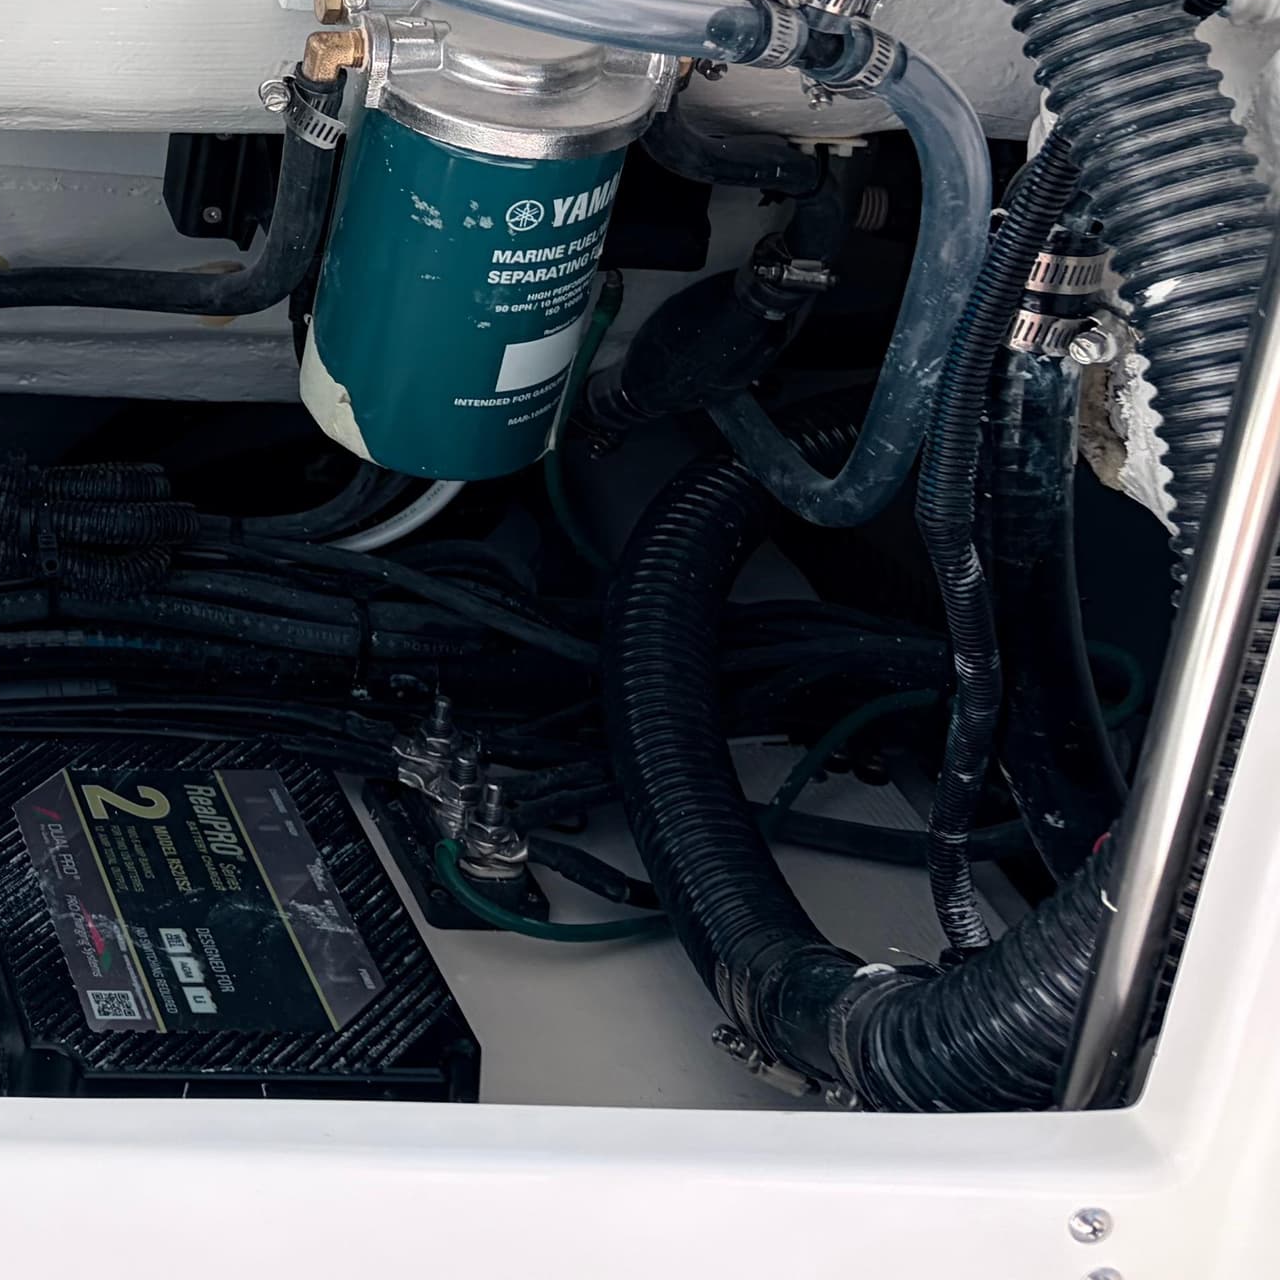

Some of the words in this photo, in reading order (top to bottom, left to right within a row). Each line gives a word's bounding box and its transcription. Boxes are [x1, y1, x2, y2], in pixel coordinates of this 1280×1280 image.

[491, 244, 567, 264] MARINE
[487, 252, 590, 285] SEPARATING
[495, 304, 509, 313] 90
[511, 303, 533, 313] GPH
[540, 299, 552, 309] 10
[526, 288, 552, 302] HIGH
[544, 306, 561, 317] ISO
[454, 398, 511, 408] INTENDED
[512, 392, 532, 404] FOR
[81, 784, 172, 820] 2
[46, 823, 70, 850] DUAL
[151, 824, 179, 856] MODEL
[56, 853, 79, 874] PRO
[184, 819, 209, 854] BATTERY
[199, 854, 226, 891] CHARGER
[216, 862, 246, 890] Series
[63, 894, 82, 912] PRO
[177, 960, 195, 979] AGM
[193, 927, 227, 973] DESIGNED
[213, 973, 236, 992] FOR
[153, 978, 179, 1014] REQUIRED
